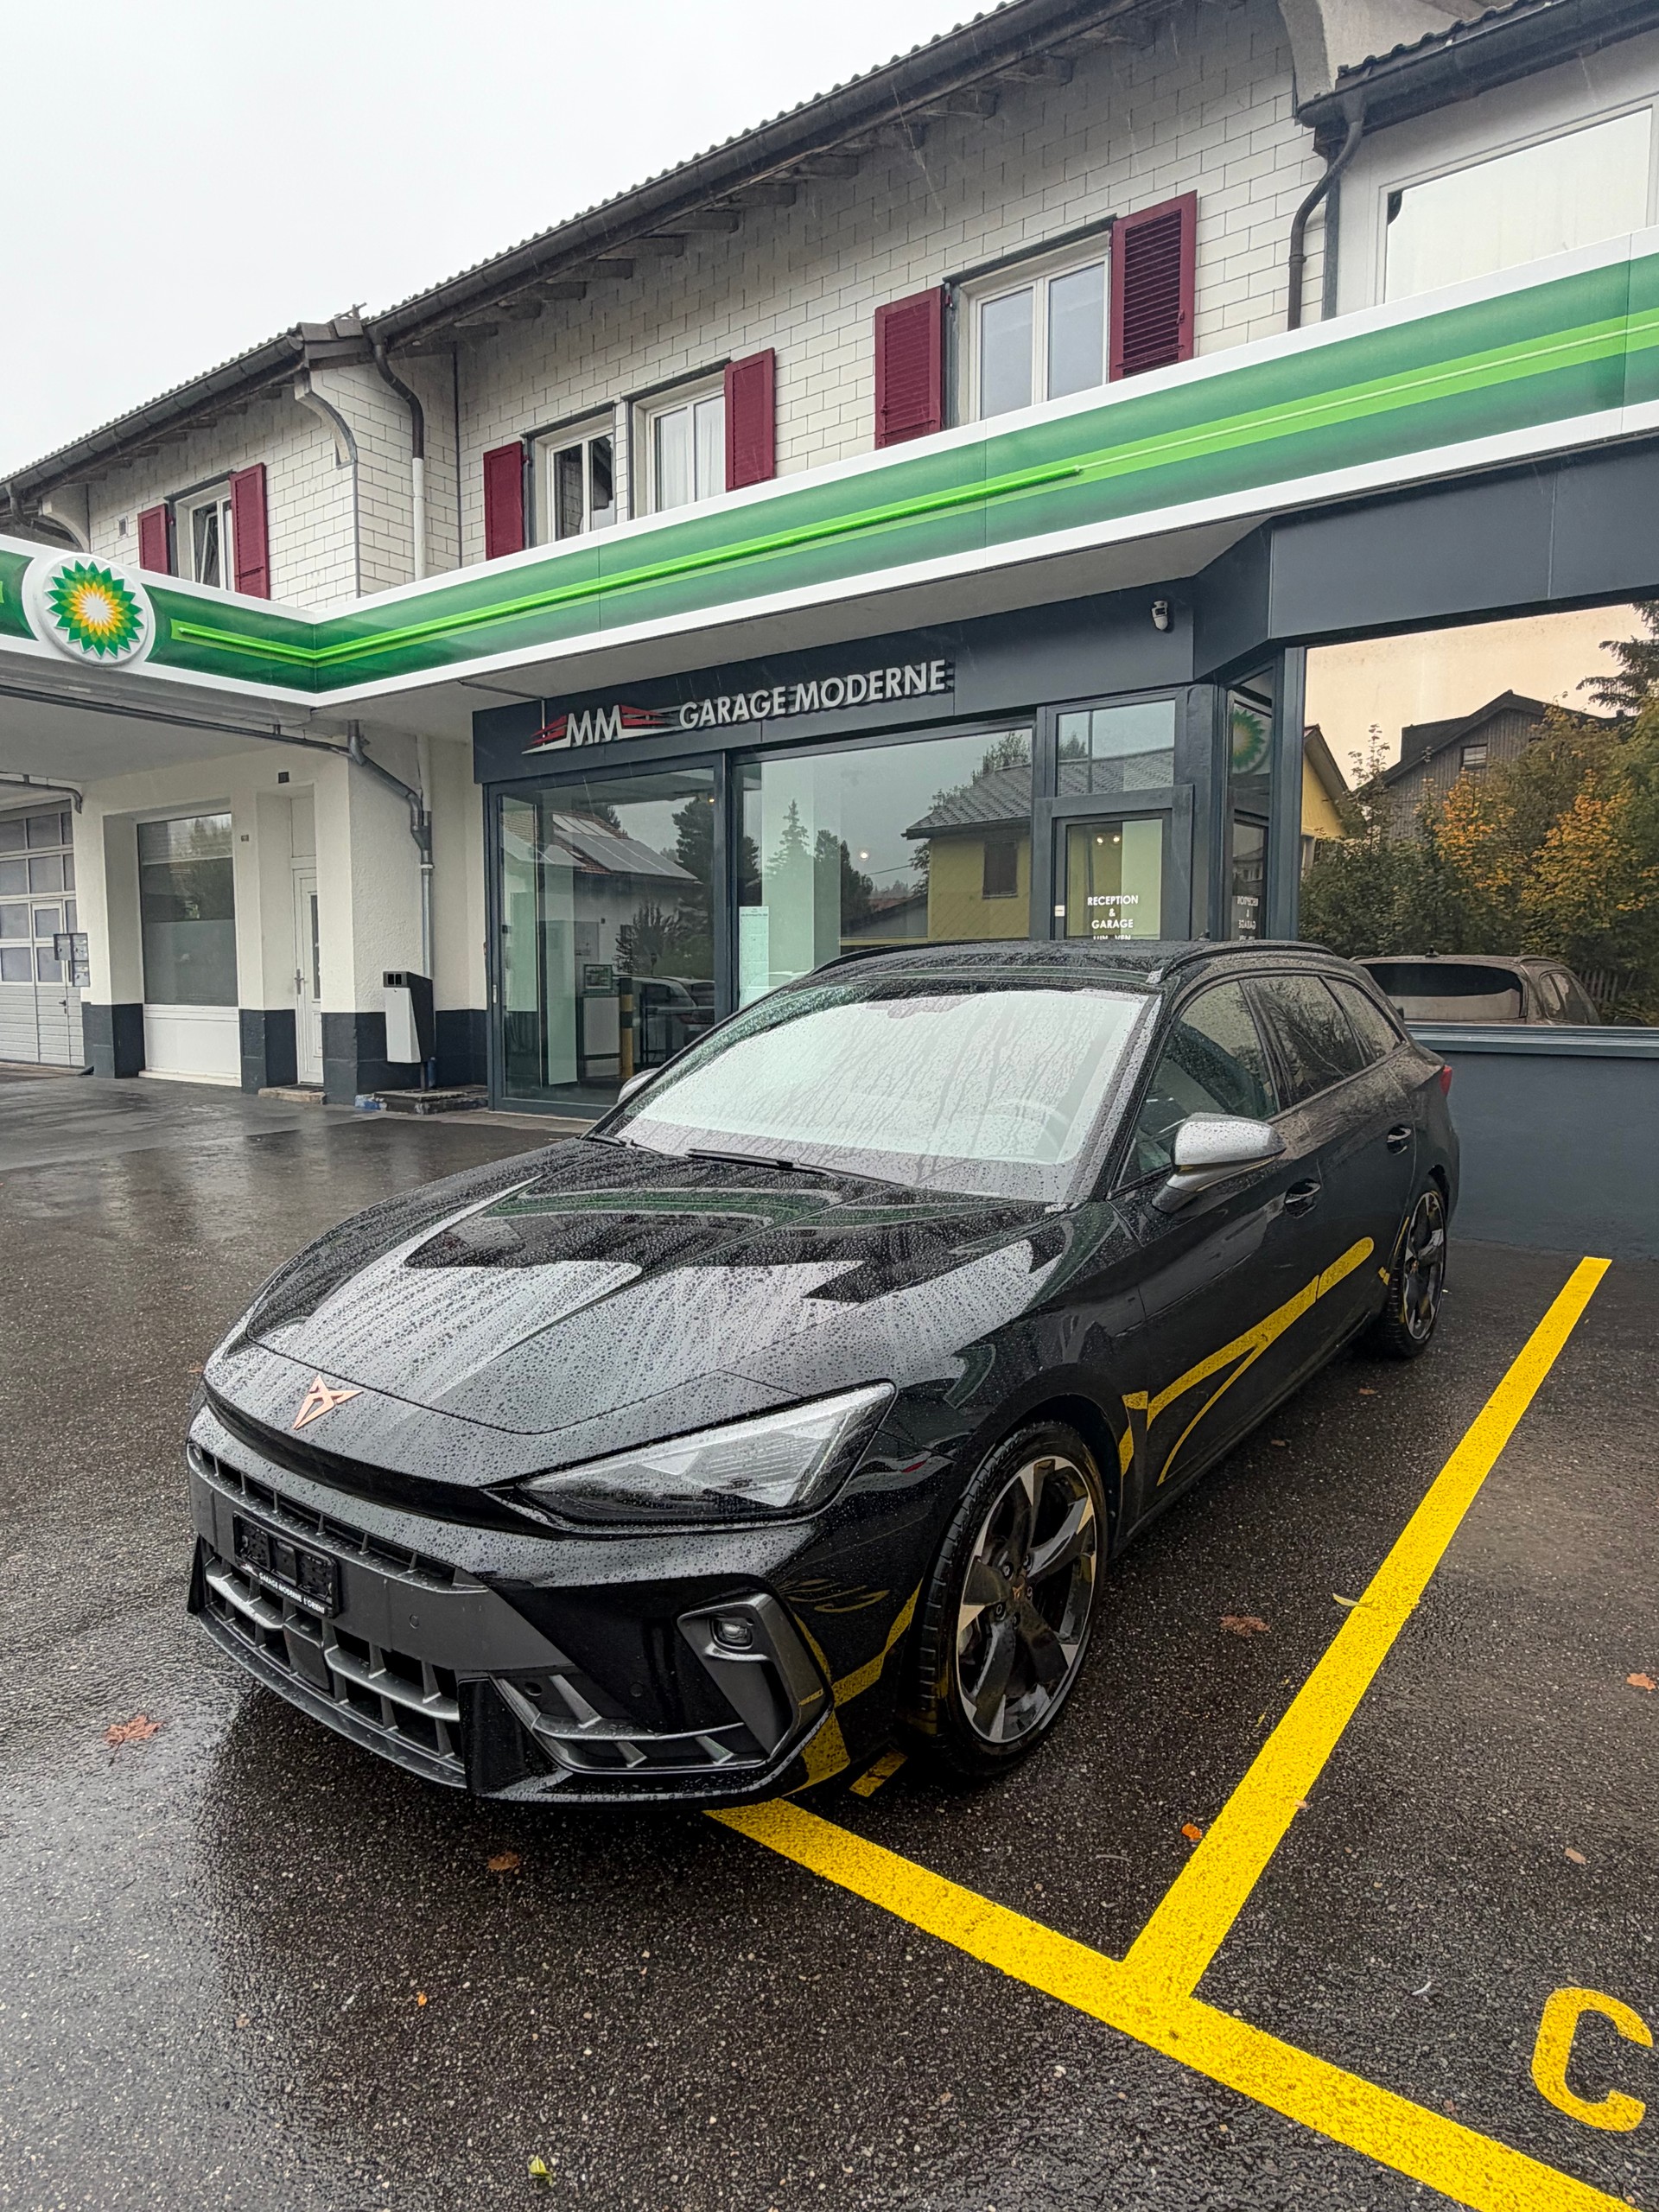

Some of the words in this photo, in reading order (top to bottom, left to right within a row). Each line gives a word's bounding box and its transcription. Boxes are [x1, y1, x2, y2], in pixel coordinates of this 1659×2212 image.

[565, 704, 624, 747] MM
[679, 686, 786, 729] GARAGE
[794, 659, 945, 712] MODERNE
[1087, 895, 1139, 906] RECEPTION
[1109, 908, 1116, 917] &
[1091, 919, 1134, 929] GARAGE
[1530, 1986, 1654, 2133] C
